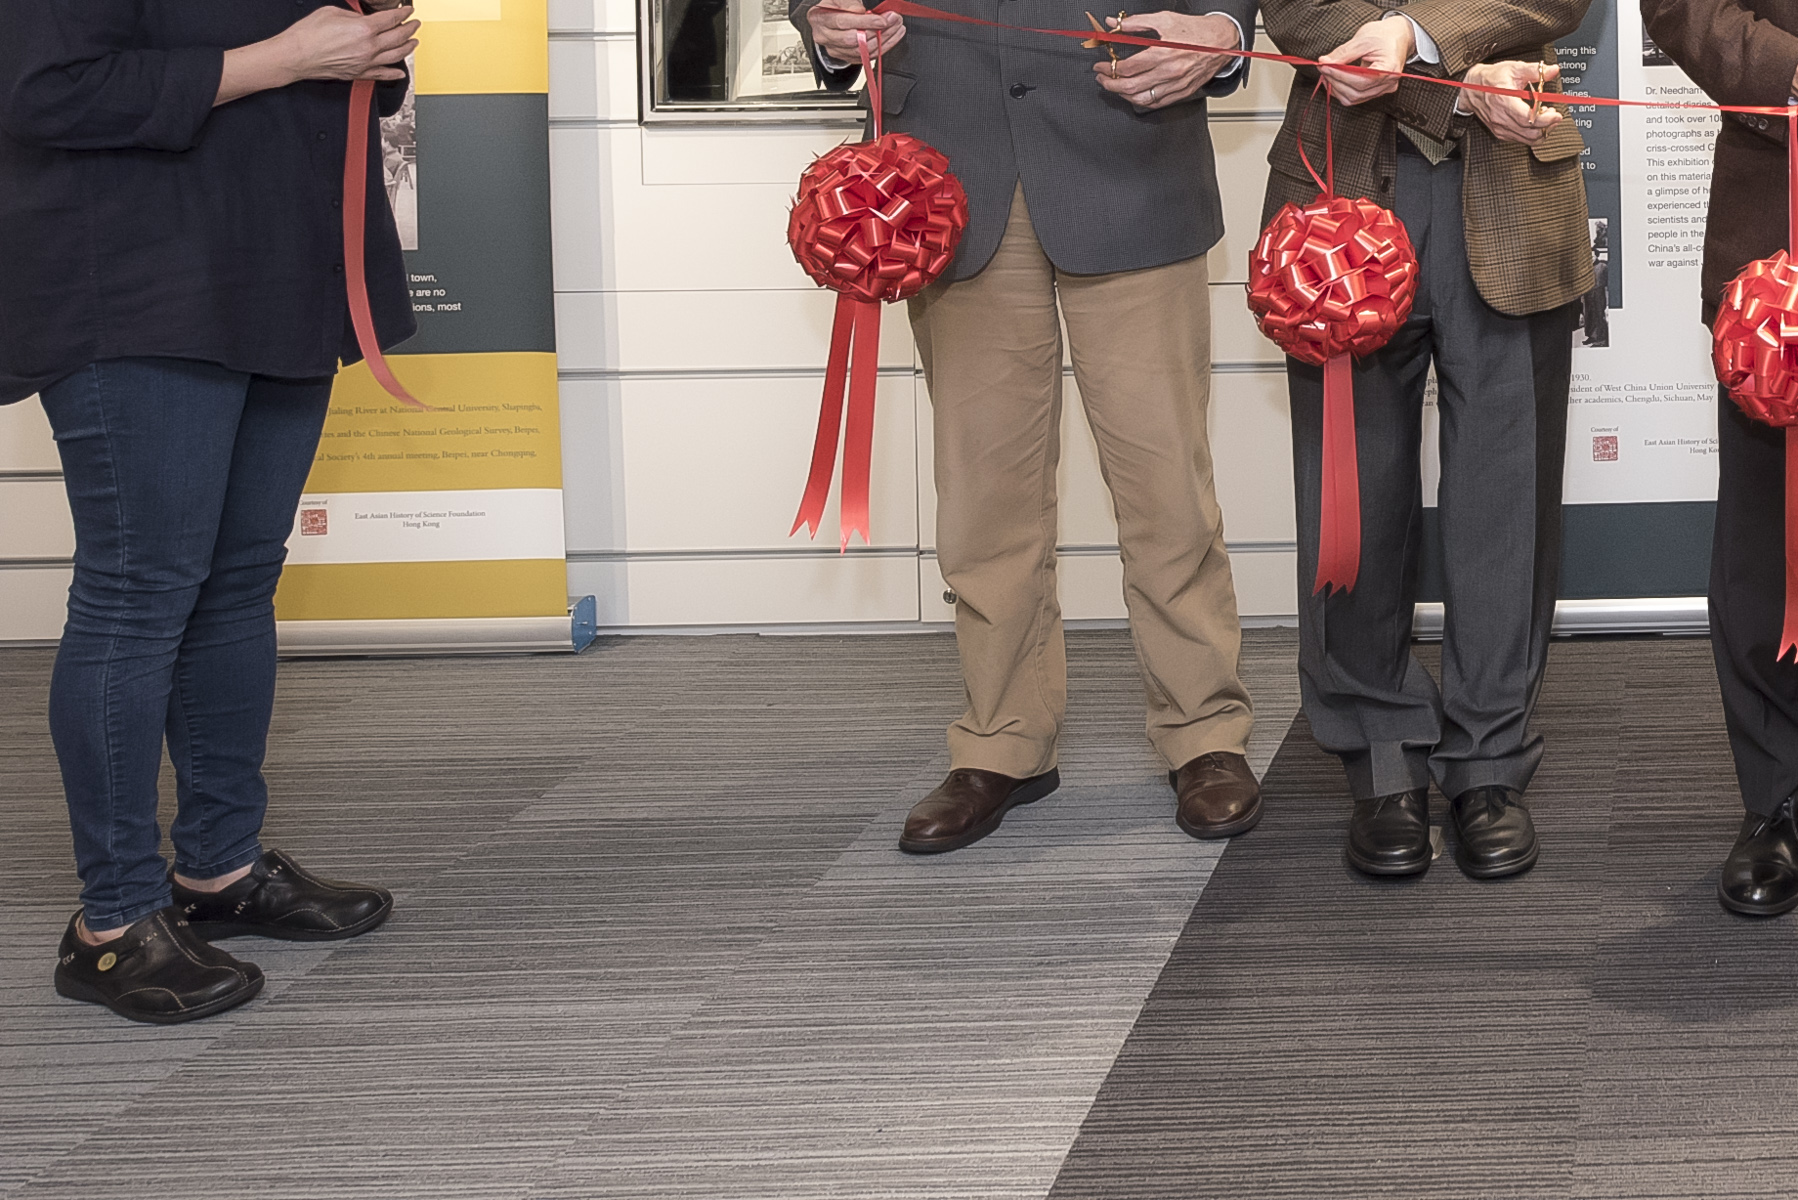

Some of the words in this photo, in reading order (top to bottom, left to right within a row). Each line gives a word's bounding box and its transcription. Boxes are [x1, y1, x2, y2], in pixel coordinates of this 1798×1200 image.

[1580, 46, 1597, 54] this
[1645, 86, 1657, 95] Dr.
[1578, 104, 1596, 112] and
[1646, 115, 1662, 123] and
[1665, 115, 1685, 123] took
[1687, 115, 1706, 123] over
[1646, 130, 1702, 139] photographs
[1646, 144, 1705, 152] criss-crossed
[1646, 158, 1665, 166] This
[1667, 158, 1710, 166] exhibition
[1646, 173, 1658, 181] on
[1660, 173, 1676, 181] this
[1655, 187, 1690, 197] glimpse
[1691, 186, 1701, 195] of
[1647, 201, 1701, 211] experienced
[1647, 215, 1689, 224] scientists
[1648, 230, 1678, 240] people
[1647, 244, 1680, 252] China's
[1666, 259, 1699, 268] against
[411, 274, 437, 283] town,
[416, 289, 431, 297] are
[433, 289, 446, 297] no
[437, 302, 462, 311] most
[1602, 384, 1621, 392] West
[1623, 383, 1647, 391] China
[1649, 383, 1673, 391] Union
[1676, 382, 1715, 391] University
[389, 512, 413, 521] History
[402, 521, 420, 529] Hong
[422, 521, 441, 529] Kong
